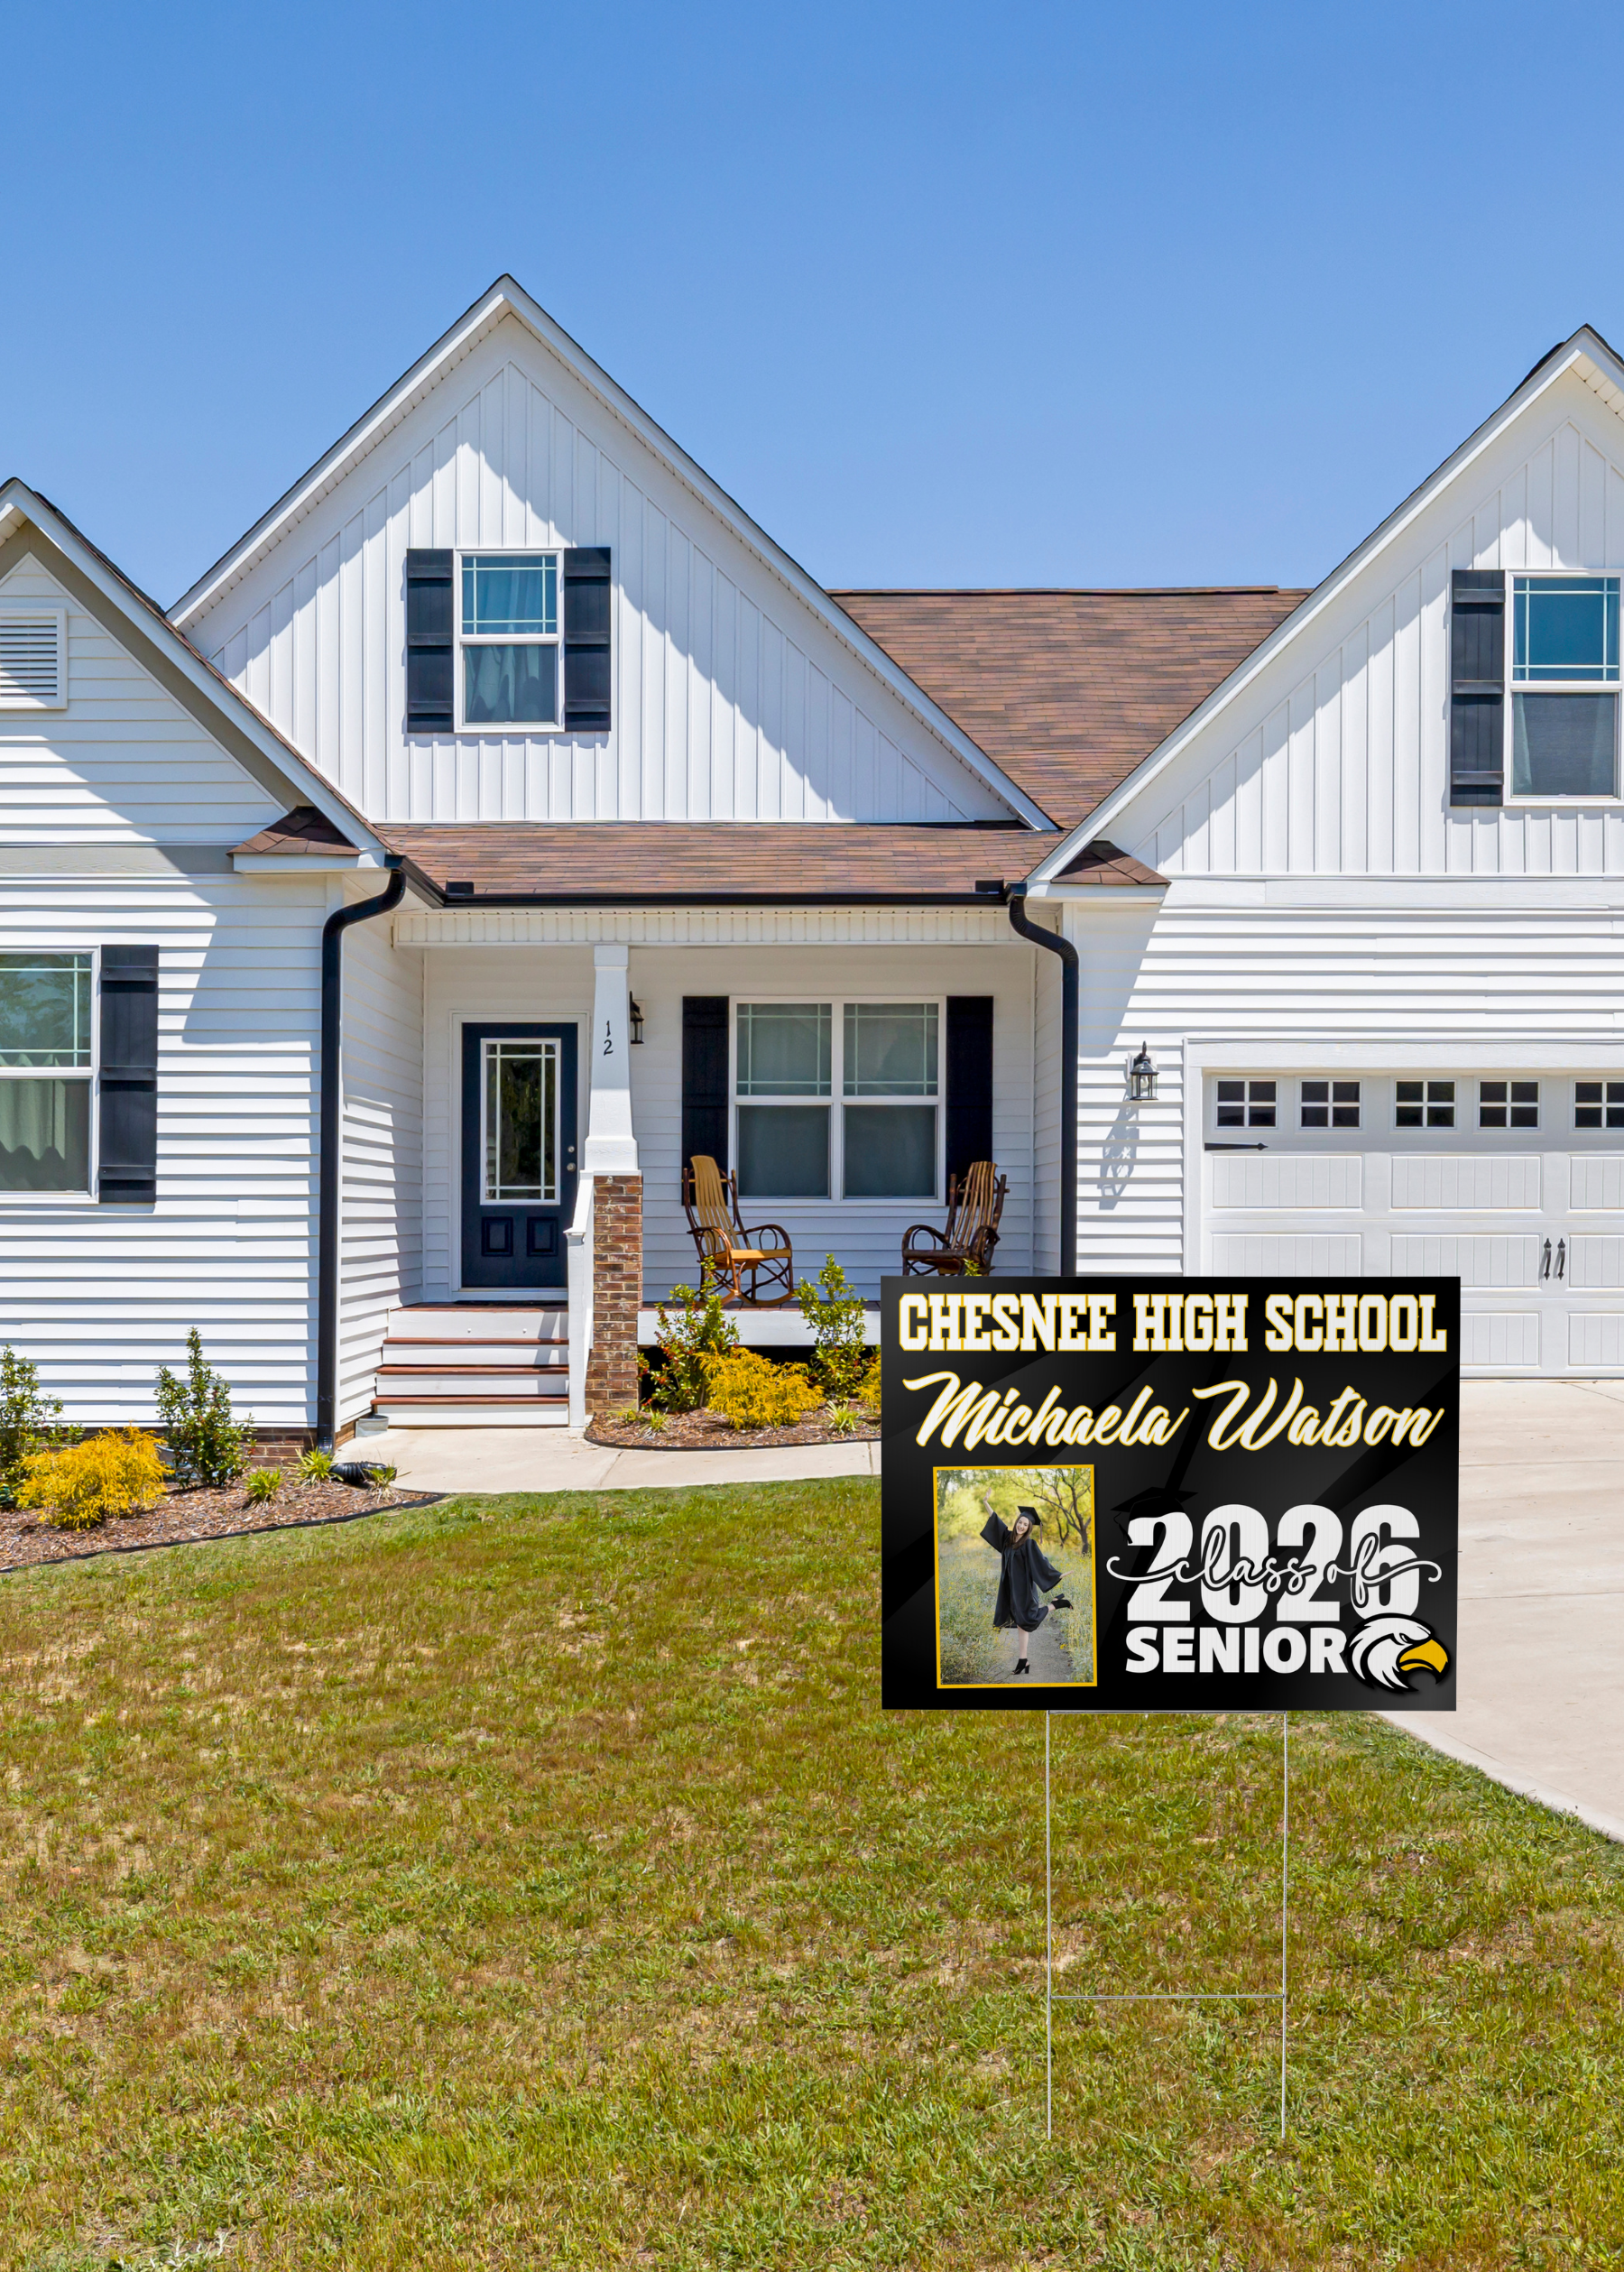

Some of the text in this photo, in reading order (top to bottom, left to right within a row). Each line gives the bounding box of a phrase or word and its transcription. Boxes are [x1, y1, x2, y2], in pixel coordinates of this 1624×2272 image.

[899, 1293, 1447, 1353] CHESNEE HIGH SCHOOL
[902, 1371, 1445, 1451] Michaela Watson
[1106, 1525, 1317, 1594] class
[1126, 1504, 1420, 1623] 2026
[1125, 1626, 1349, 1674] SENIOR
